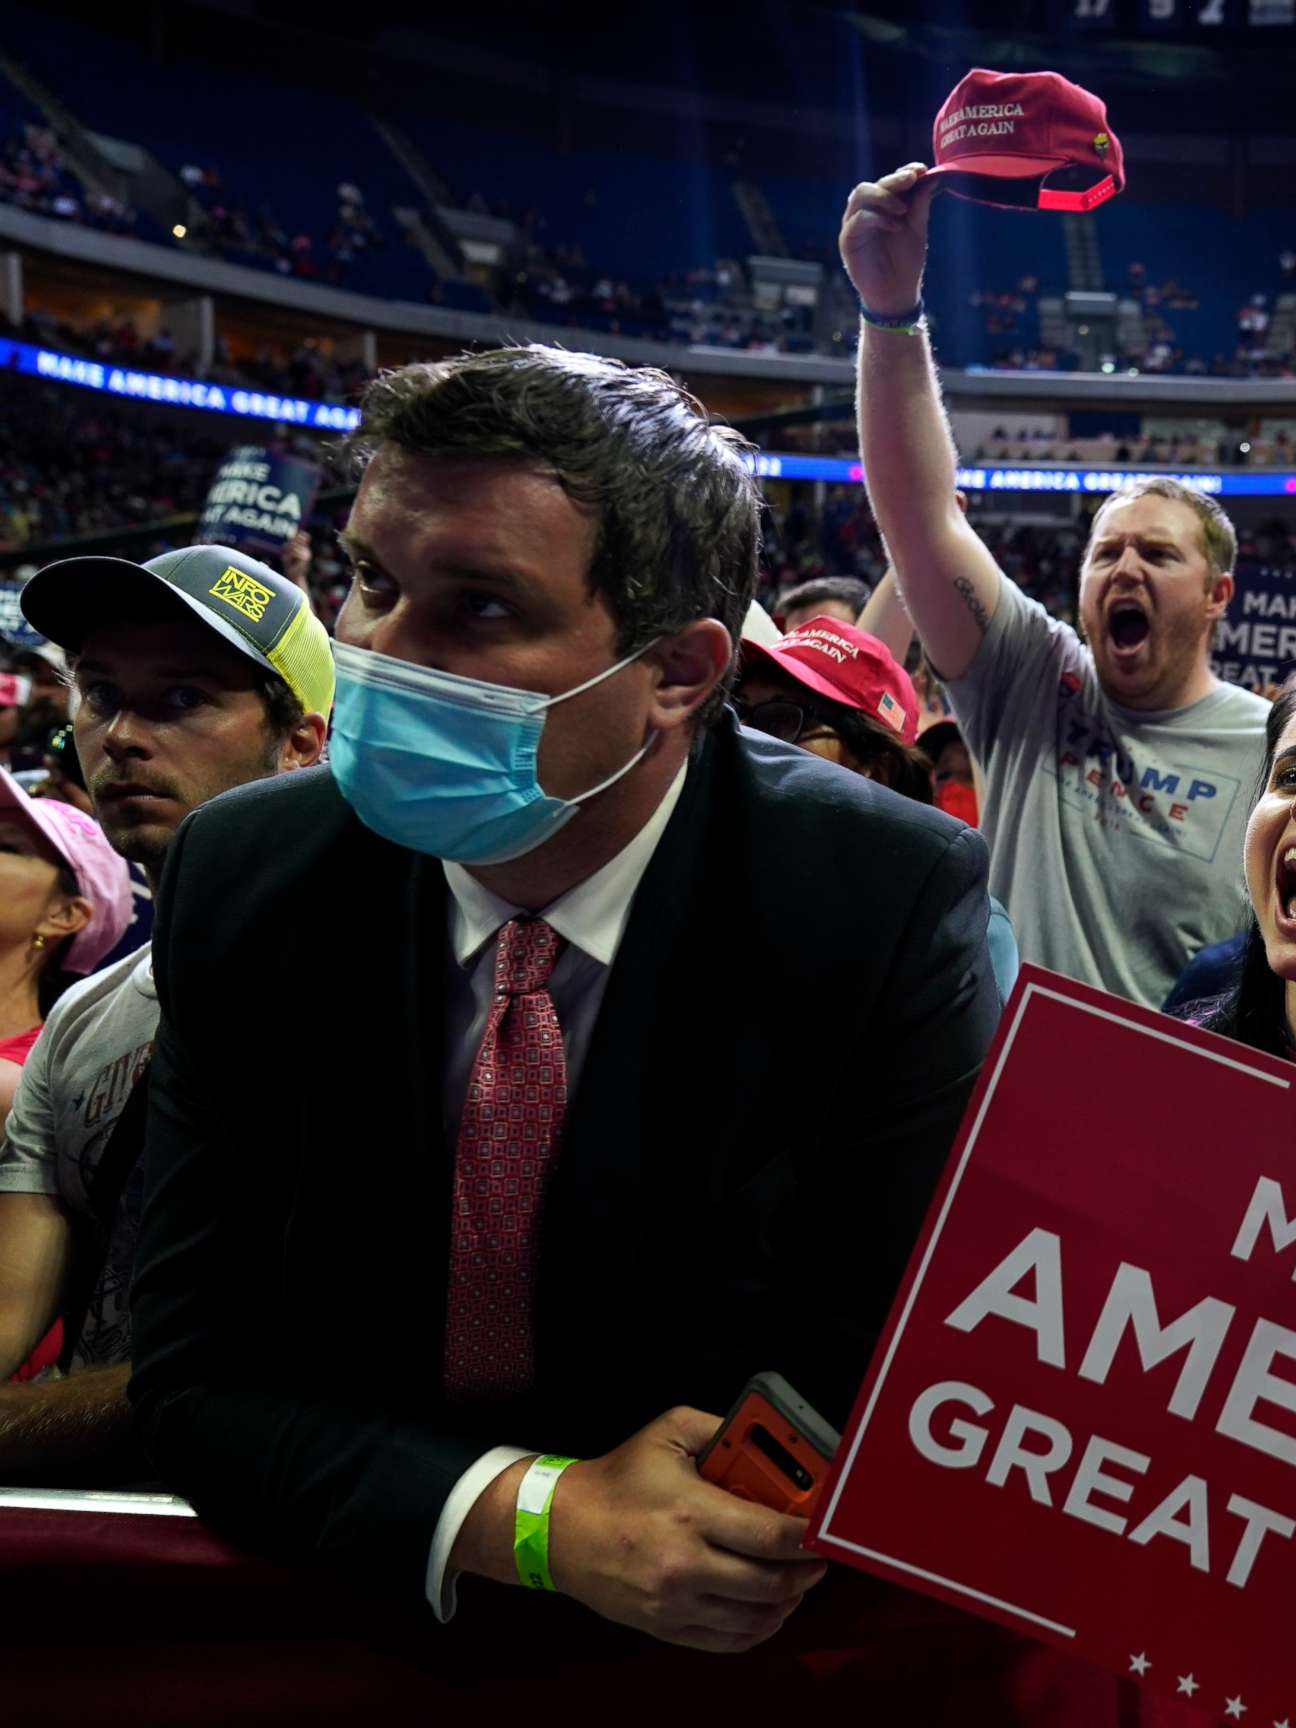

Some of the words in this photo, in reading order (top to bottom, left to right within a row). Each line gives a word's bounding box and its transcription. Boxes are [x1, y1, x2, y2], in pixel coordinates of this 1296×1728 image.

[958, 103, 1025, 120] AMERICA
[966, 121, 1015, 137] AGAIN
[108, 369, 228, 411] AMERICA
[210, 580, 266, 619] WARS
[221, 569, 270, 606] INFO
[1060, 751, 1189, 822] PENCE
[908, 1381, 1296, 1588] GREAT
